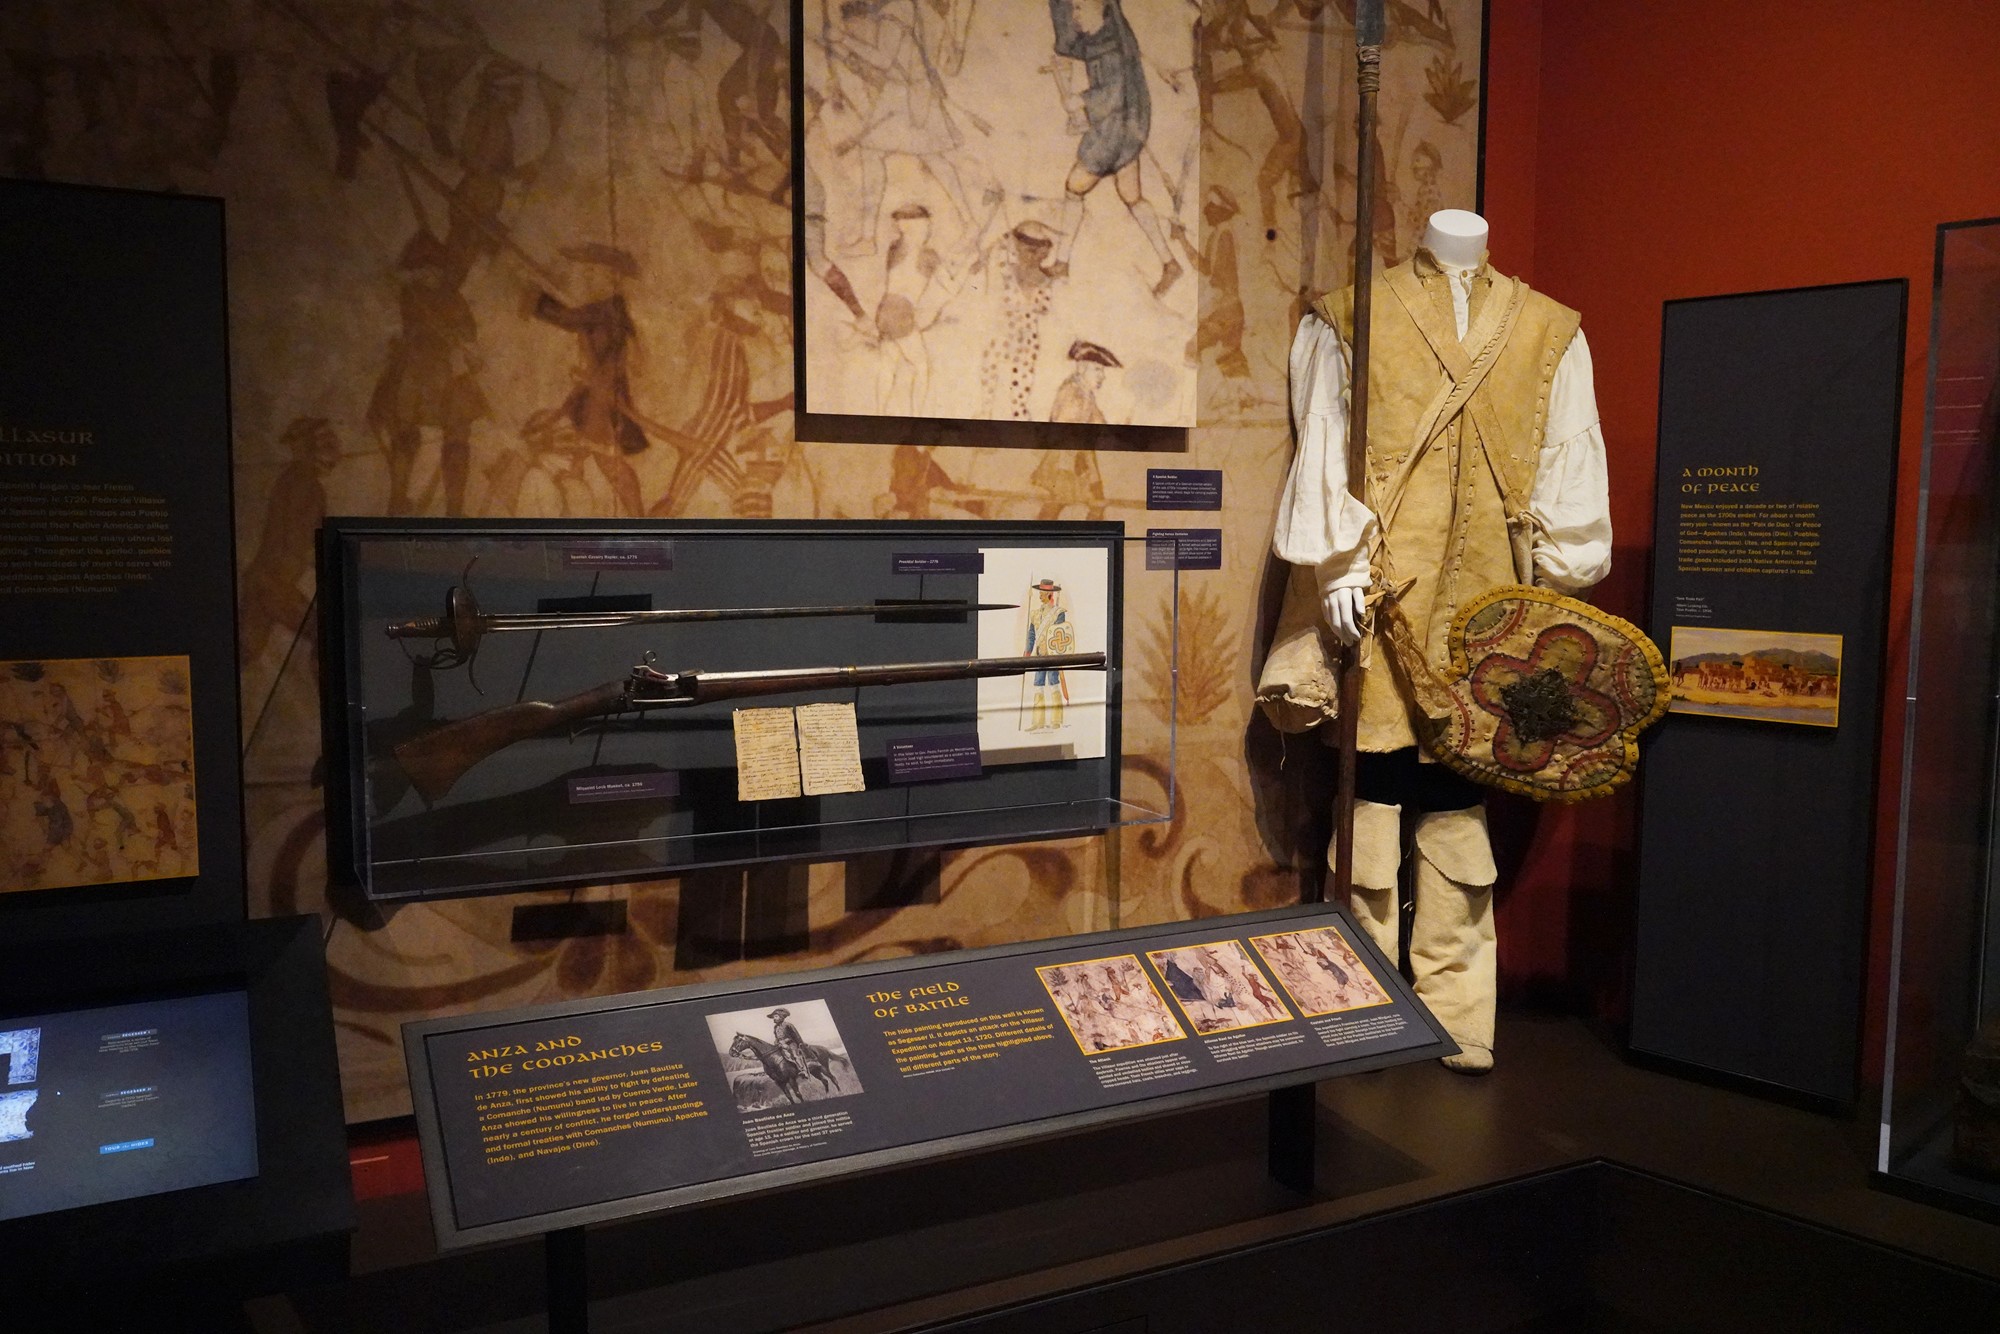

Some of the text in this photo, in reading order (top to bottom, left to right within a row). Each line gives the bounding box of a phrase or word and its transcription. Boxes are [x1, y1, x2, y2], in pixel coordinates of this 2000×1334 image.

[0, 453, 77, 466] ITION
[1682, 465, 1759, 477] A MONTH
[1681, 483, 1760, 494] OF PEACE
[866, 981, 960, 1003] THE FIELD
[874, 996, 970, 1018] OF BATTLE
[466, 1035, 583, 1062] ANZA AND
[469, 1041, 663, 1079] THE COMANCHES
[650, 1064, 683, 1073] Bautista
[535, 1091, 567, 1101] showed
[583, 1086, 608, 1094] ability
[651, 1072, 690, 1083] defeating
[487, 1109, 531, 1120] Comanche
[575, 1097, 596, 1106] band
[622, 1089, 651, 1098] Cuerno
[484, 1134, 510, 1142] nearly
[520, 1127, 552, 1136] century
[613, 1111, 640, 1120] forged
[642, 1101, 704, 1116] understandings
[505, 1117, 537, 1127] showed
[554, 1108, 600, 1119] willingness
[503, 1140, 531, 1149] formal
[533, 1135, 564, 1145] treaties
[584, 1124, 632, 1136] Comanches
[675, 1111, 708, 1120] Apaches
[518, 1150, 534, 1158] and
[537, 1145, 571, 1155] Navajos
